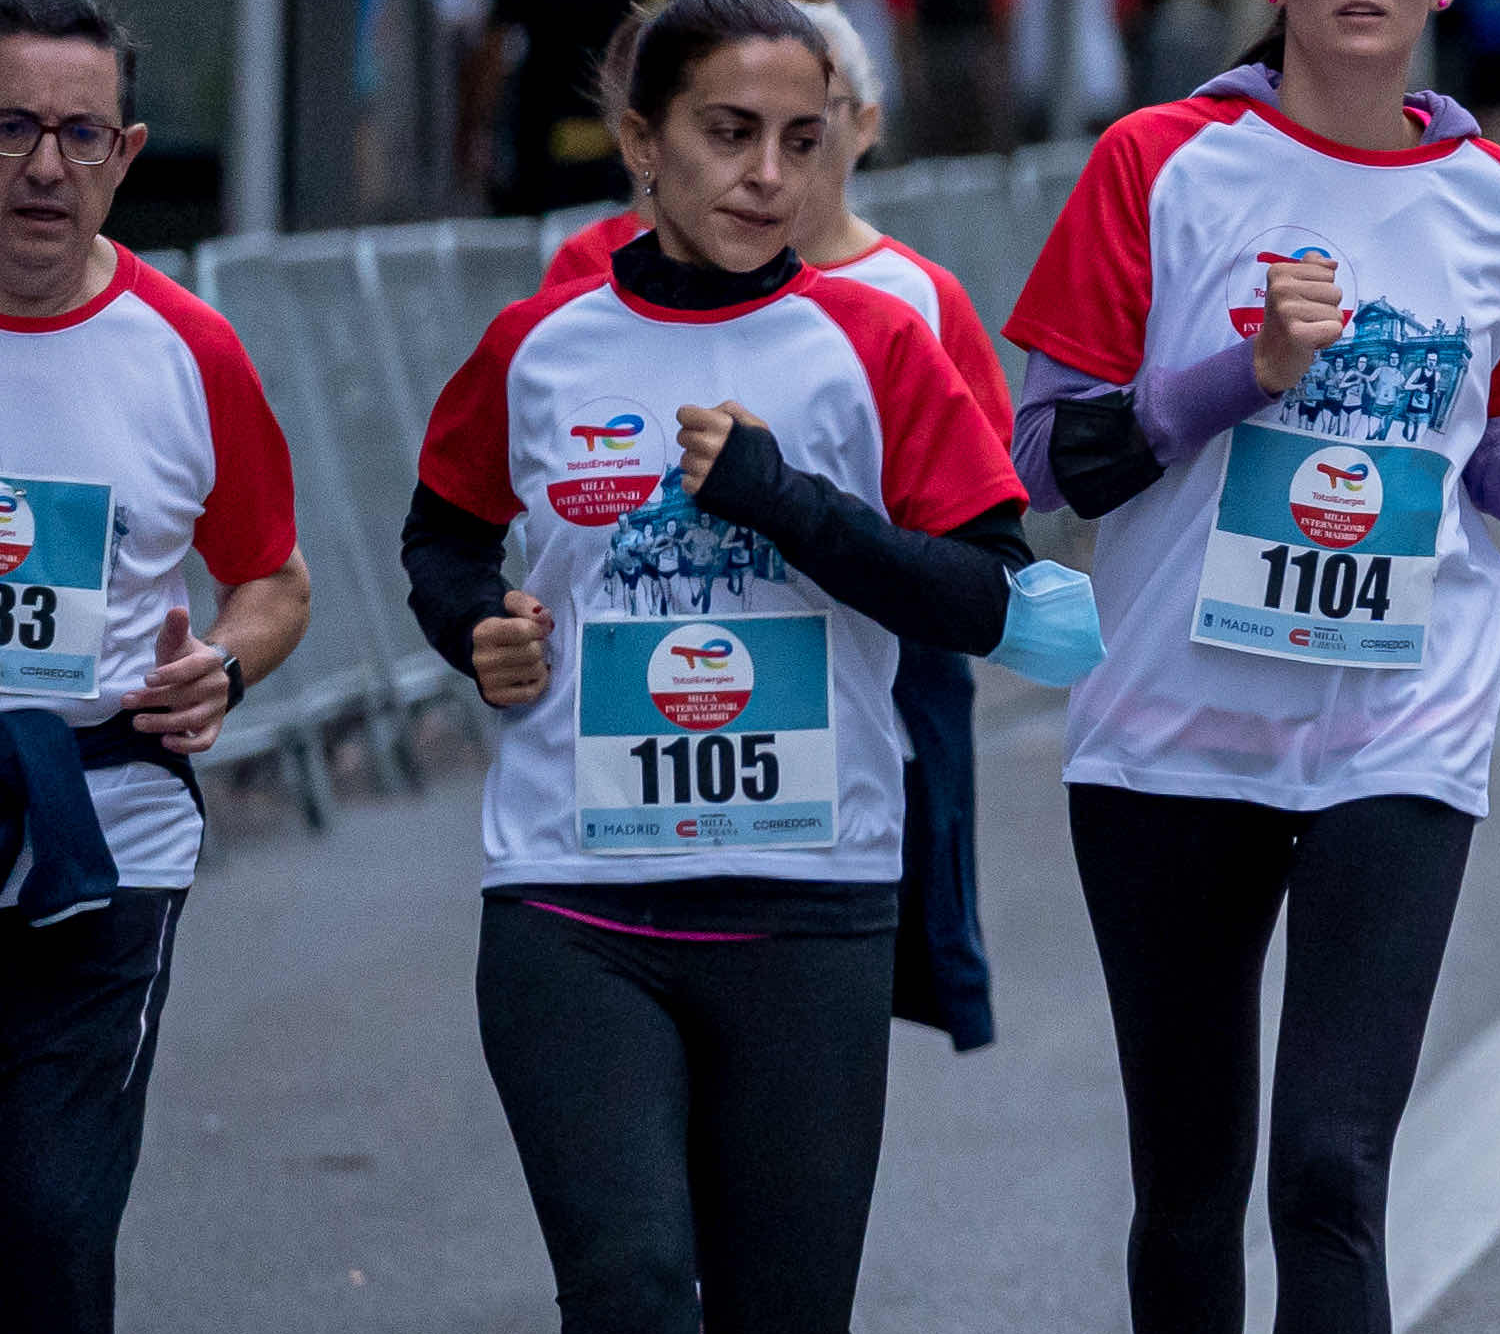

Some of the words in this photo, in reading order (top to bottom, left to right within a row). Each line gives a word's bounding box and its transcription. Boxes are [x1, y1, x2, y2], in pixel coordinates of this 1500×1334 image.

[1323, 512, 1351, 522] MILLA
[1309, 528, 1324, 538] DE
[1261, 544, 1392, 622] 1104
[1220, 618, 1274, 637] MADRID
[687, 694, 718, 703] MILLA
[676, 713, 691, 723] DE
[630, 733, 780, 805] 1105
[603, 823, 660, 836] MADRID
